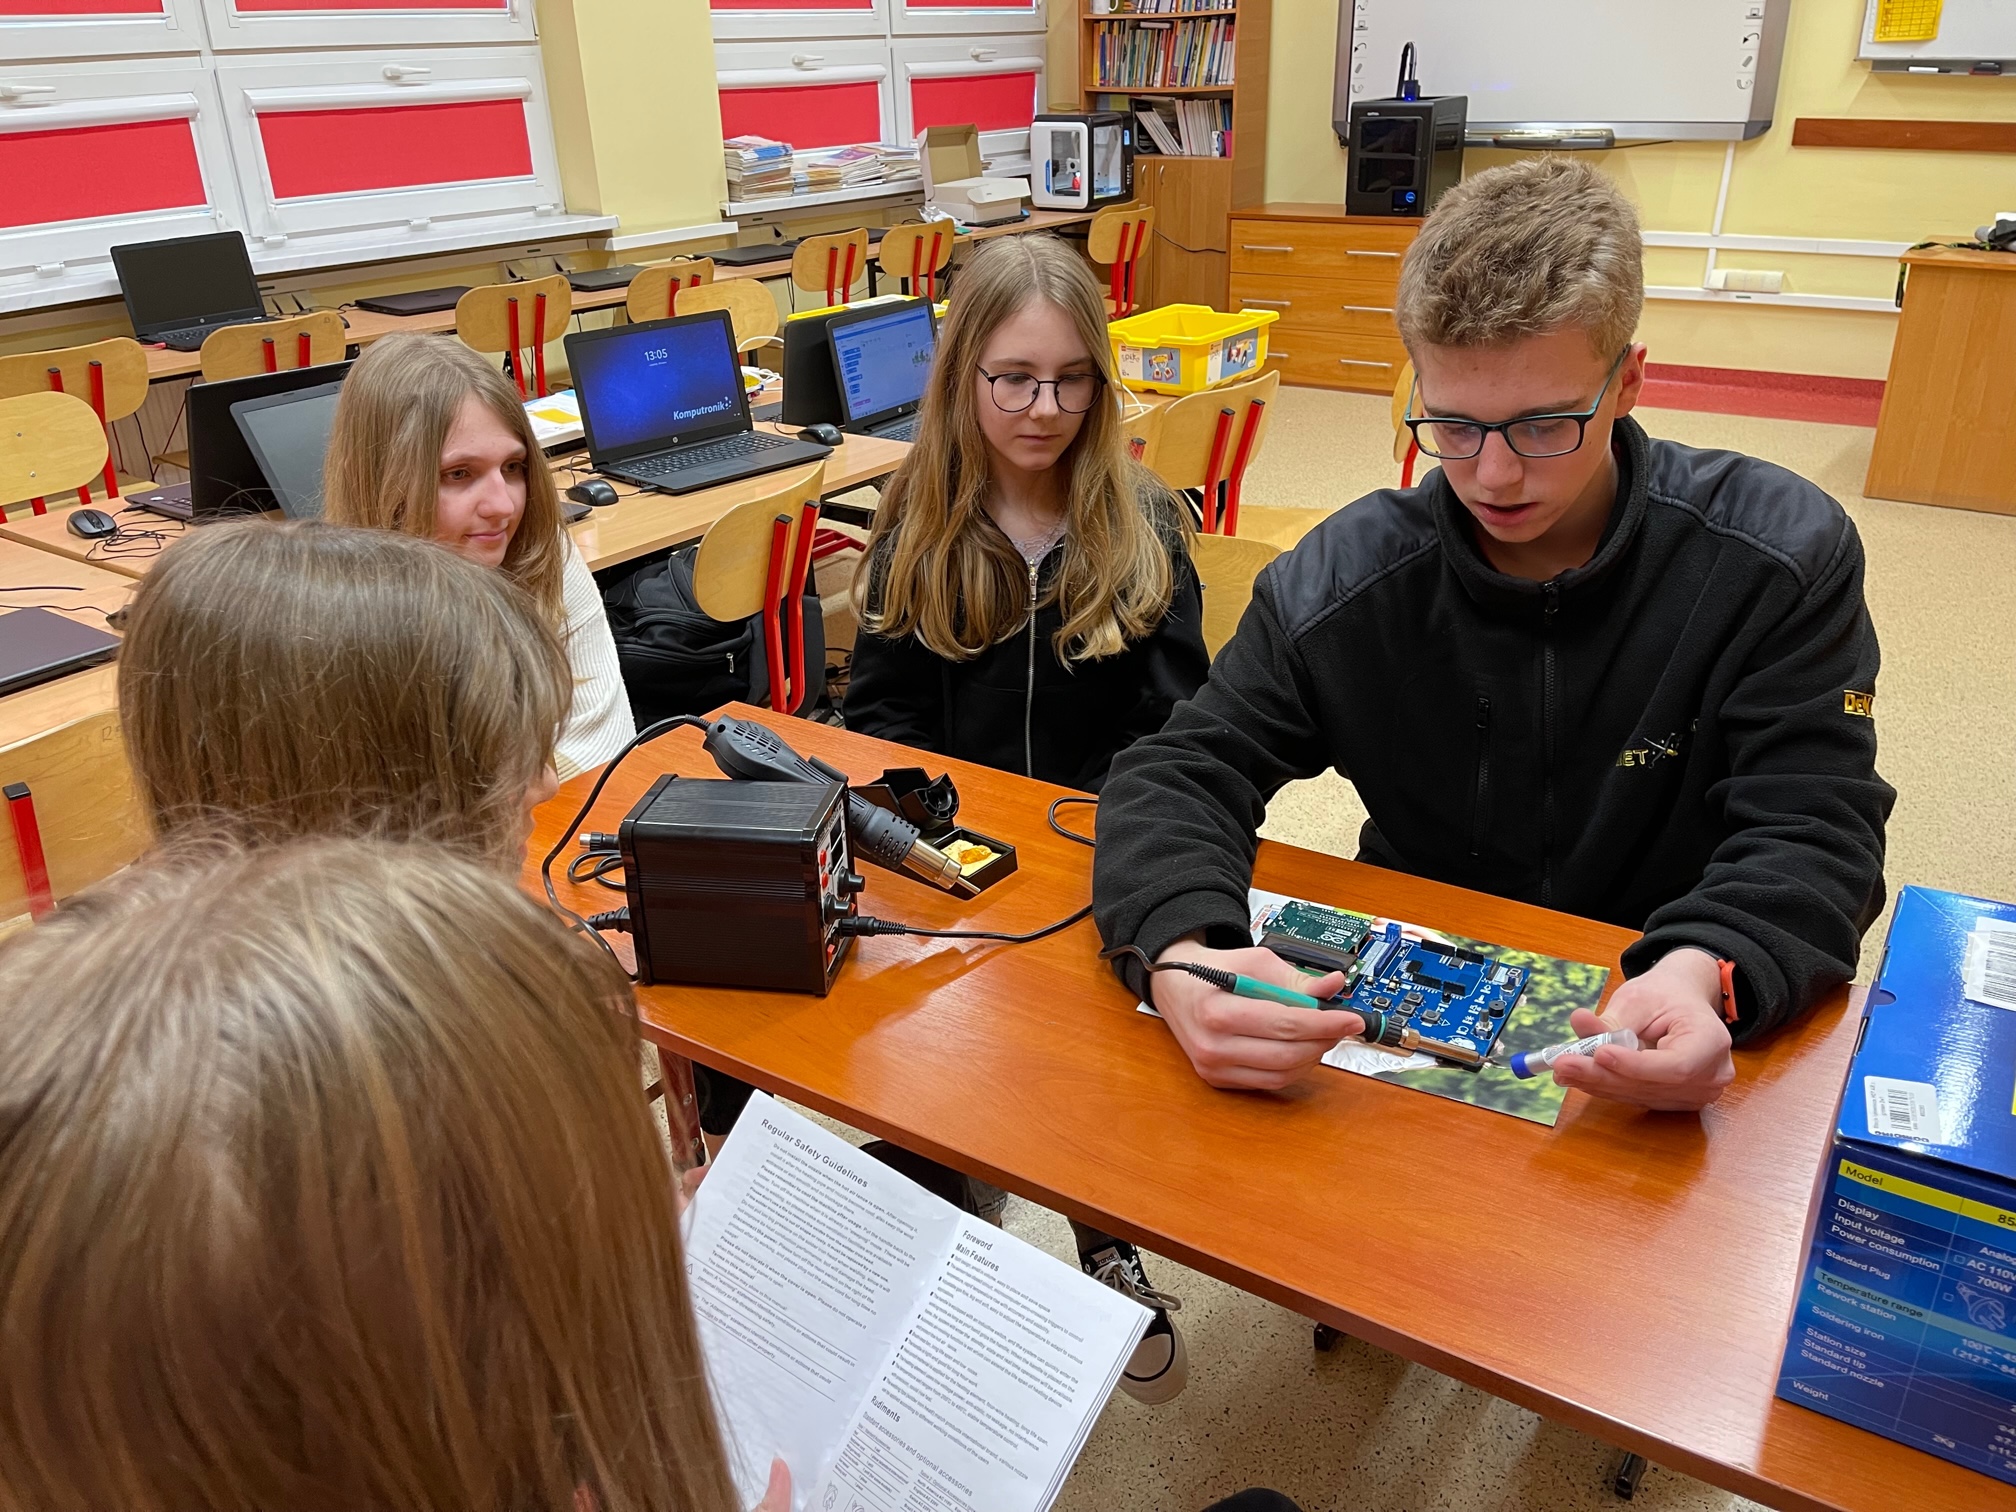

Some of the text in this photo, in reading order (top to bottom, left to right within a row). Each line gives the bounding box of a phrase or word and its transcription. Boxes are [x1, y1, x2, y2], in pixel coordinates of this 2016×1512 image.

[644, 348, 668, 362] 13:05
[673, 401, 725, 421] Komputronik
[760, 1118, 868, 1187] Regular Safety Guidelines
[1846, 1166, 1883, 1186] Model
[1838, 1198, 1879, 1221] Display
[1998, 1214, 2016, 1226] 85
[962, 1229, 993, 1250] Foreword
[1834, 1212, 1905, 1245] Input voltage
[954, 1242, 999, 1272] Main Features
[1831, 1225, 1940, 1270] Power consumption
[1826, 1249, 1890, 1280] Standard Plug
[1967, 1259, 1987, 1271] AC
[1821, 1272, 1924, 1318] Temperature range
[1977, 1275, 2013, 1294] 700W
[1817, 1283, 1897, 1321] Rework station
[1812, 1305, 1885, 1341] Soldering iron
[1803, 1338, 1866, 1370] Standard tip
[1806, 1327, 1867, 1358] Station size
[1801, 1349, 1885, 1388] Standard nozzle
[1793, 1380, 1829, 1401] Weight
[870, 1395, 900, 1422] Rudiments
[862, 1411, 972, 1496] Standard accessories and optional accessories
